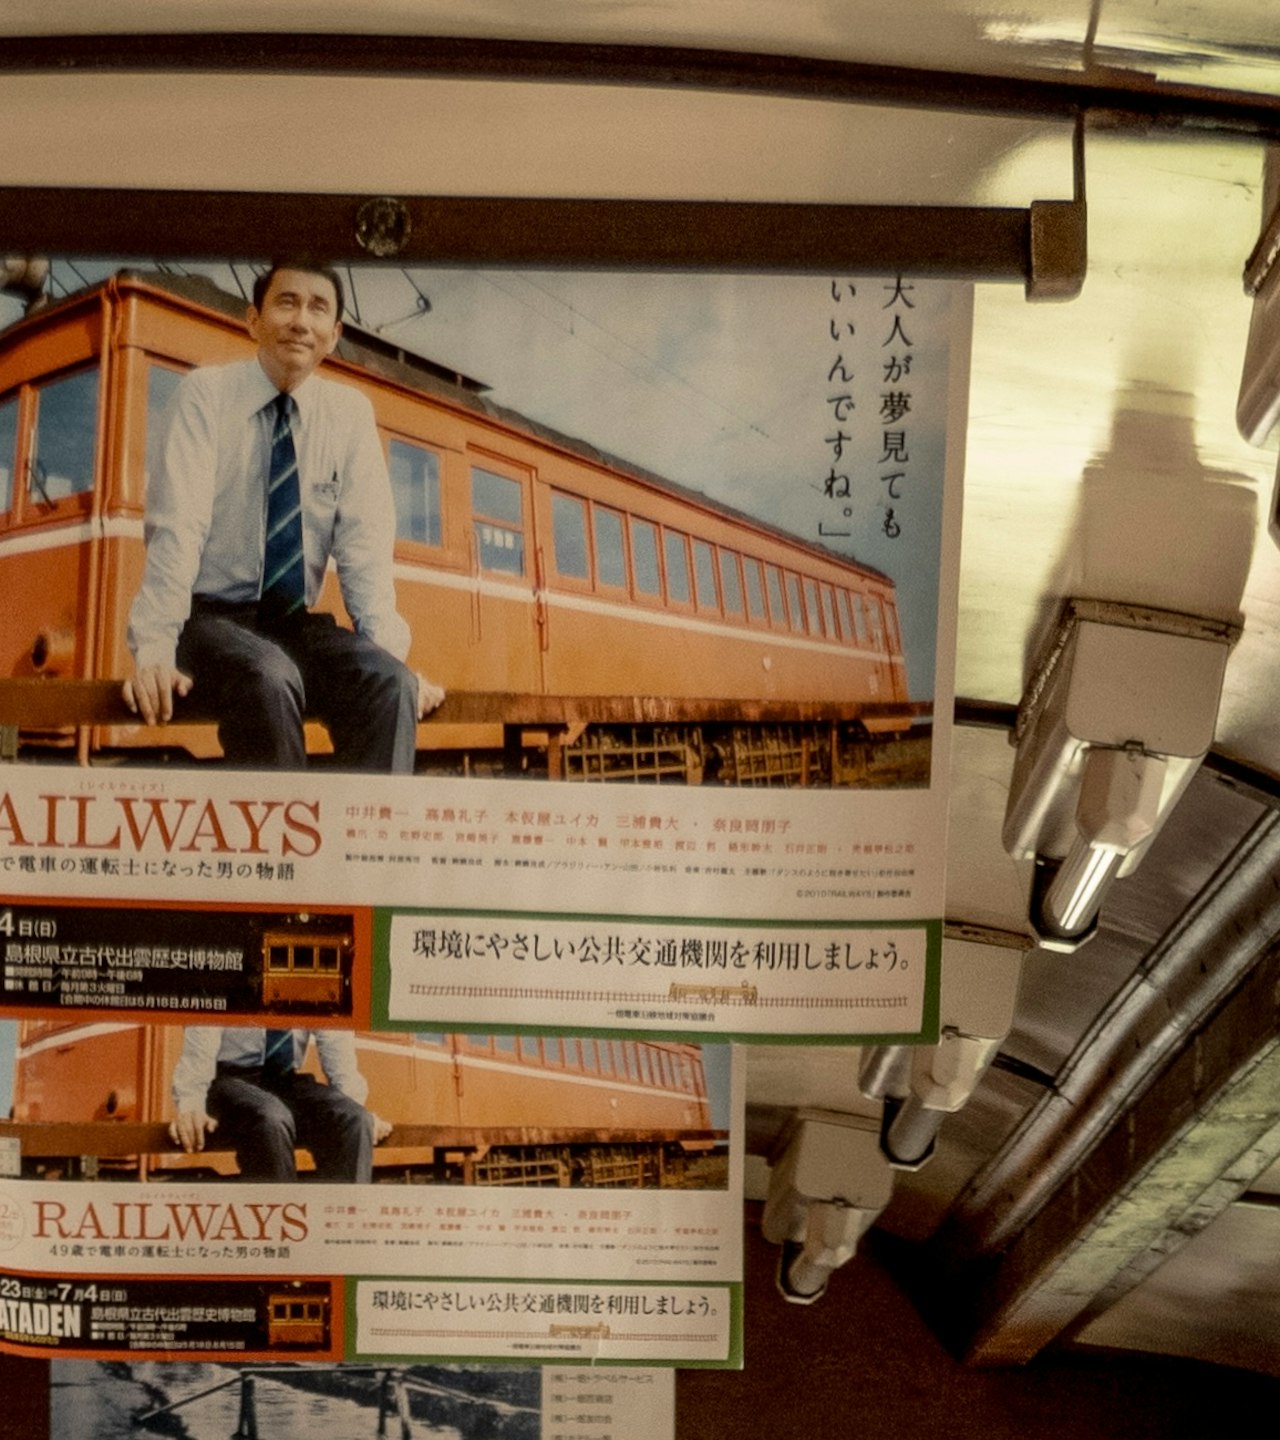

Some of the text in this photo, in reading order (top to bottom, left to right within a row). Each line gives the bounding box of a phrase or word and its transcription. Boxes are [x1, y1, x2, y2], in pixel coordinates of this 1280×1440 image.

[818, 279, 857, 537] いいんですね。」
[877, 274, 915, 539] 大人が夢見ても
[4, 943, 245, 972] 島根県立古代出雲歴史博物館
[412, 929, 910, 972] 環境にやさしい公共交通機関を利用しましょう。
[31, 1200, 311, 1242] RAILWAYS
[48, 1244, 291, 1260] 49歳で電車の運転士になった男の物語
[371, 1289, 718, 1318] 環境にやさしい公共交通機関を利用しましょう。
